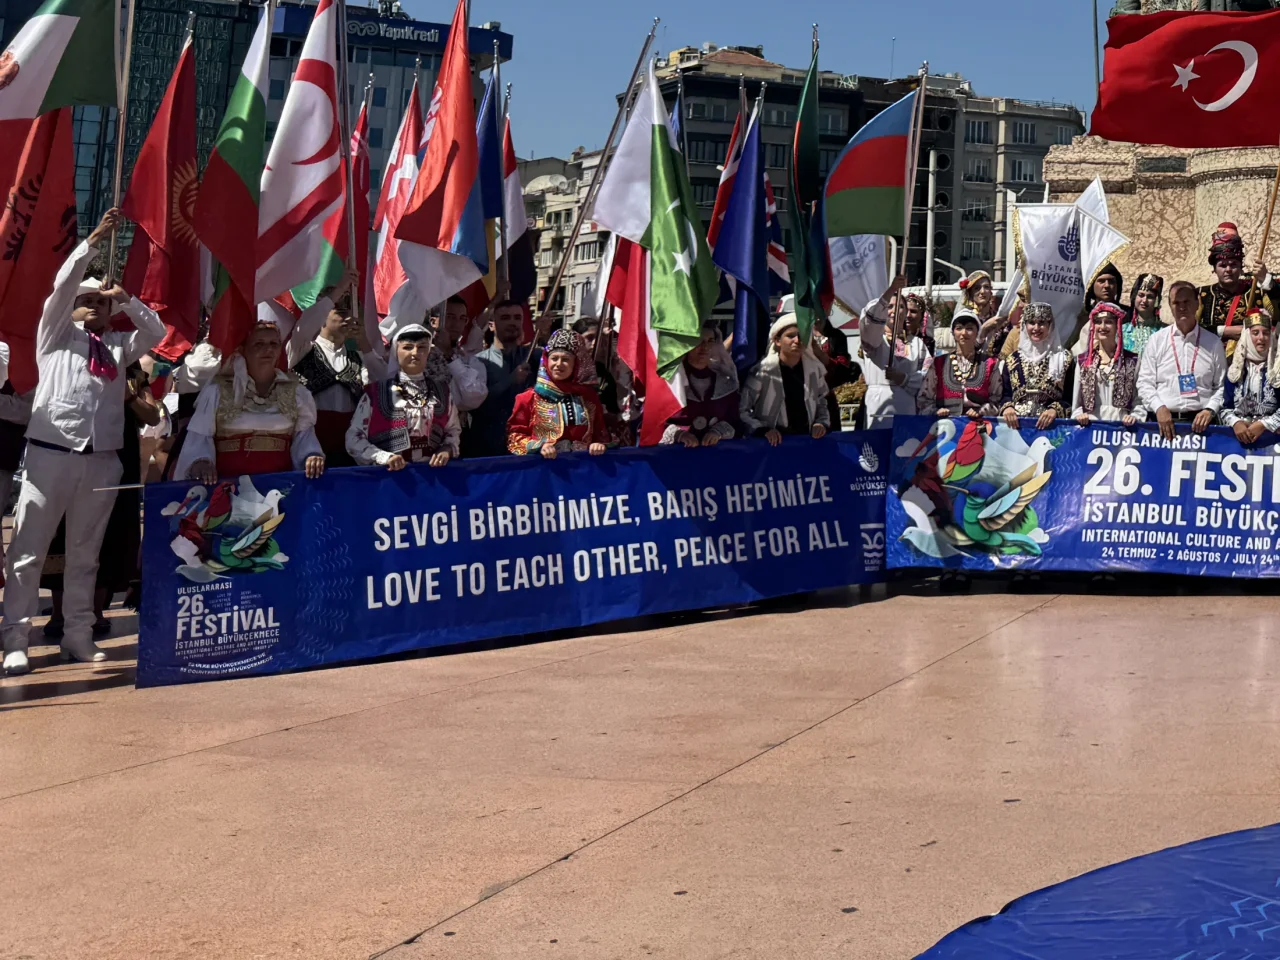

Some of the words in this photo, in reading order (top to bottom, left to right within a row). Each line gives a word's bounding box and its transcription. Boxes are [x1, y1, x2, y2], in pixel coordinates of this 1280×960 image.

[378, 23, 439, 42] YapıKredi
[1092, 430, 1206, 450] ULUSLARARASI
[1083, 448, 1153, 496] 26.
[374, 504, 459, 552] SEVGİ
[470, 492, 640, 540] BİRBİRİMİZE,
[647, 486, 718, 522] BARIŞ
[726, 473, 834, 514] HEPİMİZE
[1083, 497, 1187, 526] İSTANBUL
[1082, 529, 1181, 546] INTERNATIONAL
[1186, 534, 1240, 549] CULTURE
[1246, 537, 1270, 550] AND
[366, 567, 441, 610] LOVE
[451, 562, 486, 598] TO
[496, 553, 564, 592] EACH
[573, 542, 668, 583] OTHER,
[674, 532, 748, 569] PEACE
[754, 526, 801, 560] FOR
[809, 520, 849, 552] ALL
[1102, 547, 1114, 558] 24
[1118, 547, 1156, 558] TEMMUZ
[1168, 550, 1174, 560] 2
[1177, 548, 1220, 563] AĞUSTOS
[1224, 552, 1229, 563] /
[1232, 553, 1258, 564] JULY
[1261, 554, 1280, 565] 24th
[177, 582, 232, 594] ULUSLARARASI
[176, 594, 210, 618] 26.
[176, 605, 280, 640] FESTİVAL
[176, 638, 214, 650] İSTANBUL
[218, 628, 280, 644] BÜYÜKÇEKMECE
